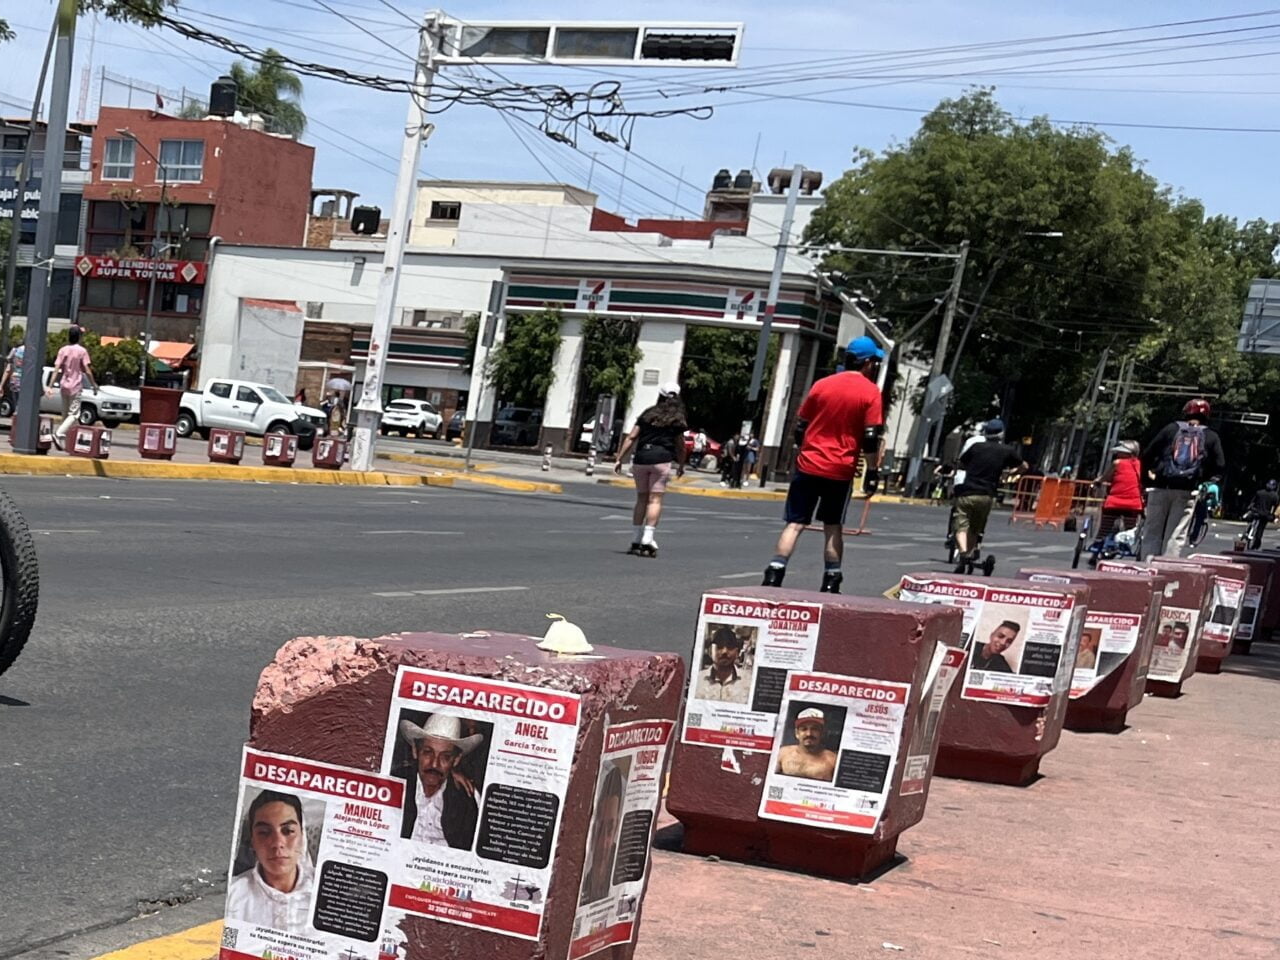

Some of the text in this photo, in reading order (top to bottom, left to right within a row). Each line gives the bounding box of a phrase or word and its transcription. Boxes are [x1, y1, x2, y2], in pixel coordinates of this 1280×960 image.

[97, 268, 131, 276] SUPER
[992, 593, 1066, 608] DESAPARECIDO
[713, 603, 811, 620] DESAPARECIDO
[1161, 609, 1192, 620] BUSCA
[768, 621, 808, 631] JONATHAN
[799, 680, 896, 700] DESAPARECIDO
[412, 681, 565, 719] DESAPARECIDO
[865, 704, 888, 715] JESÚS
[515, 722, 548, 740] ANGEL
[531, 744, 557, 754] Torres
[254, 763, 391, 802] DESAPARECIDO
[344, 803, 382, 822] MANUEL
